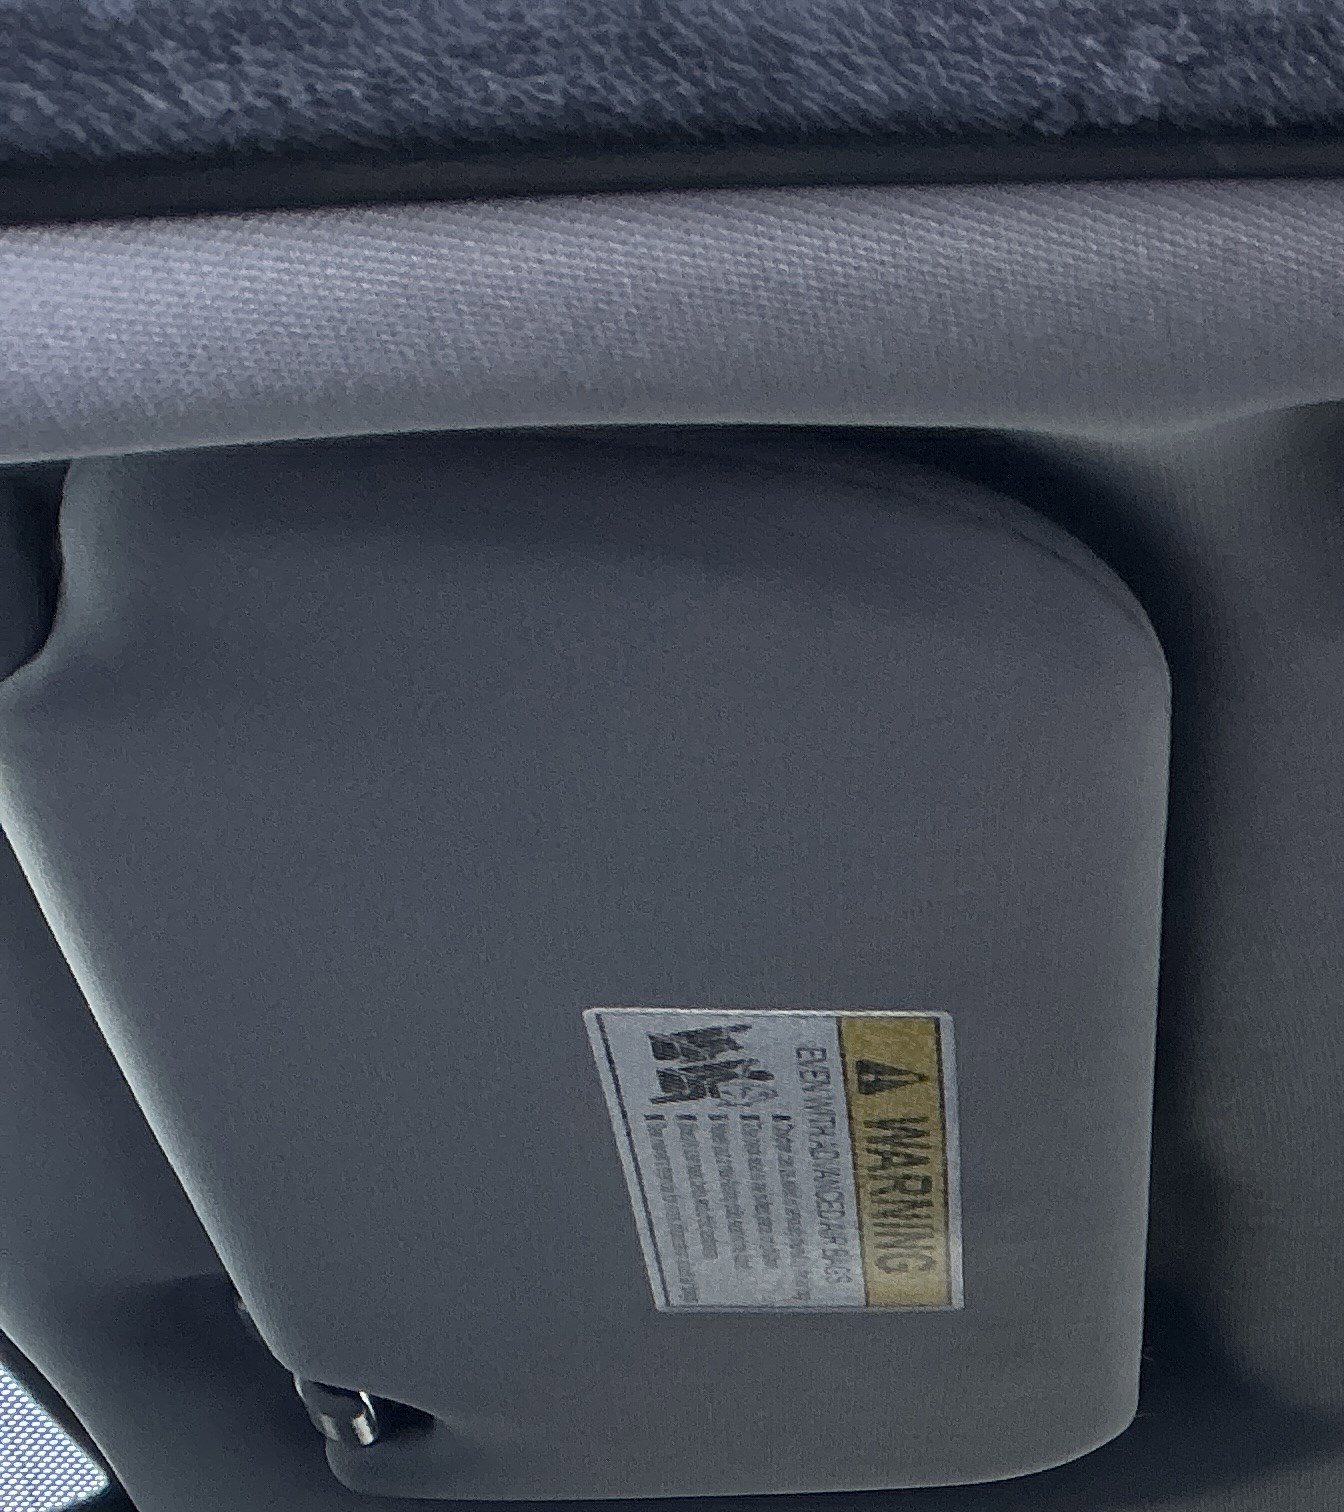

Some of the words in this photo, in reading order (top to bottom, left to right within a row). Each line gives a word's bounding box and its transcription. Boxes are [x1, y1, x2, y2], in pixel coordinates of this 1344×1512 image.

[796, 1047, 832, 1093] EVEN
[803, 1095, 837, 1137] WITH
[809, 1139, 846, 1218] ADVANCED
[863, 1115, 937, 1274] WARNING
